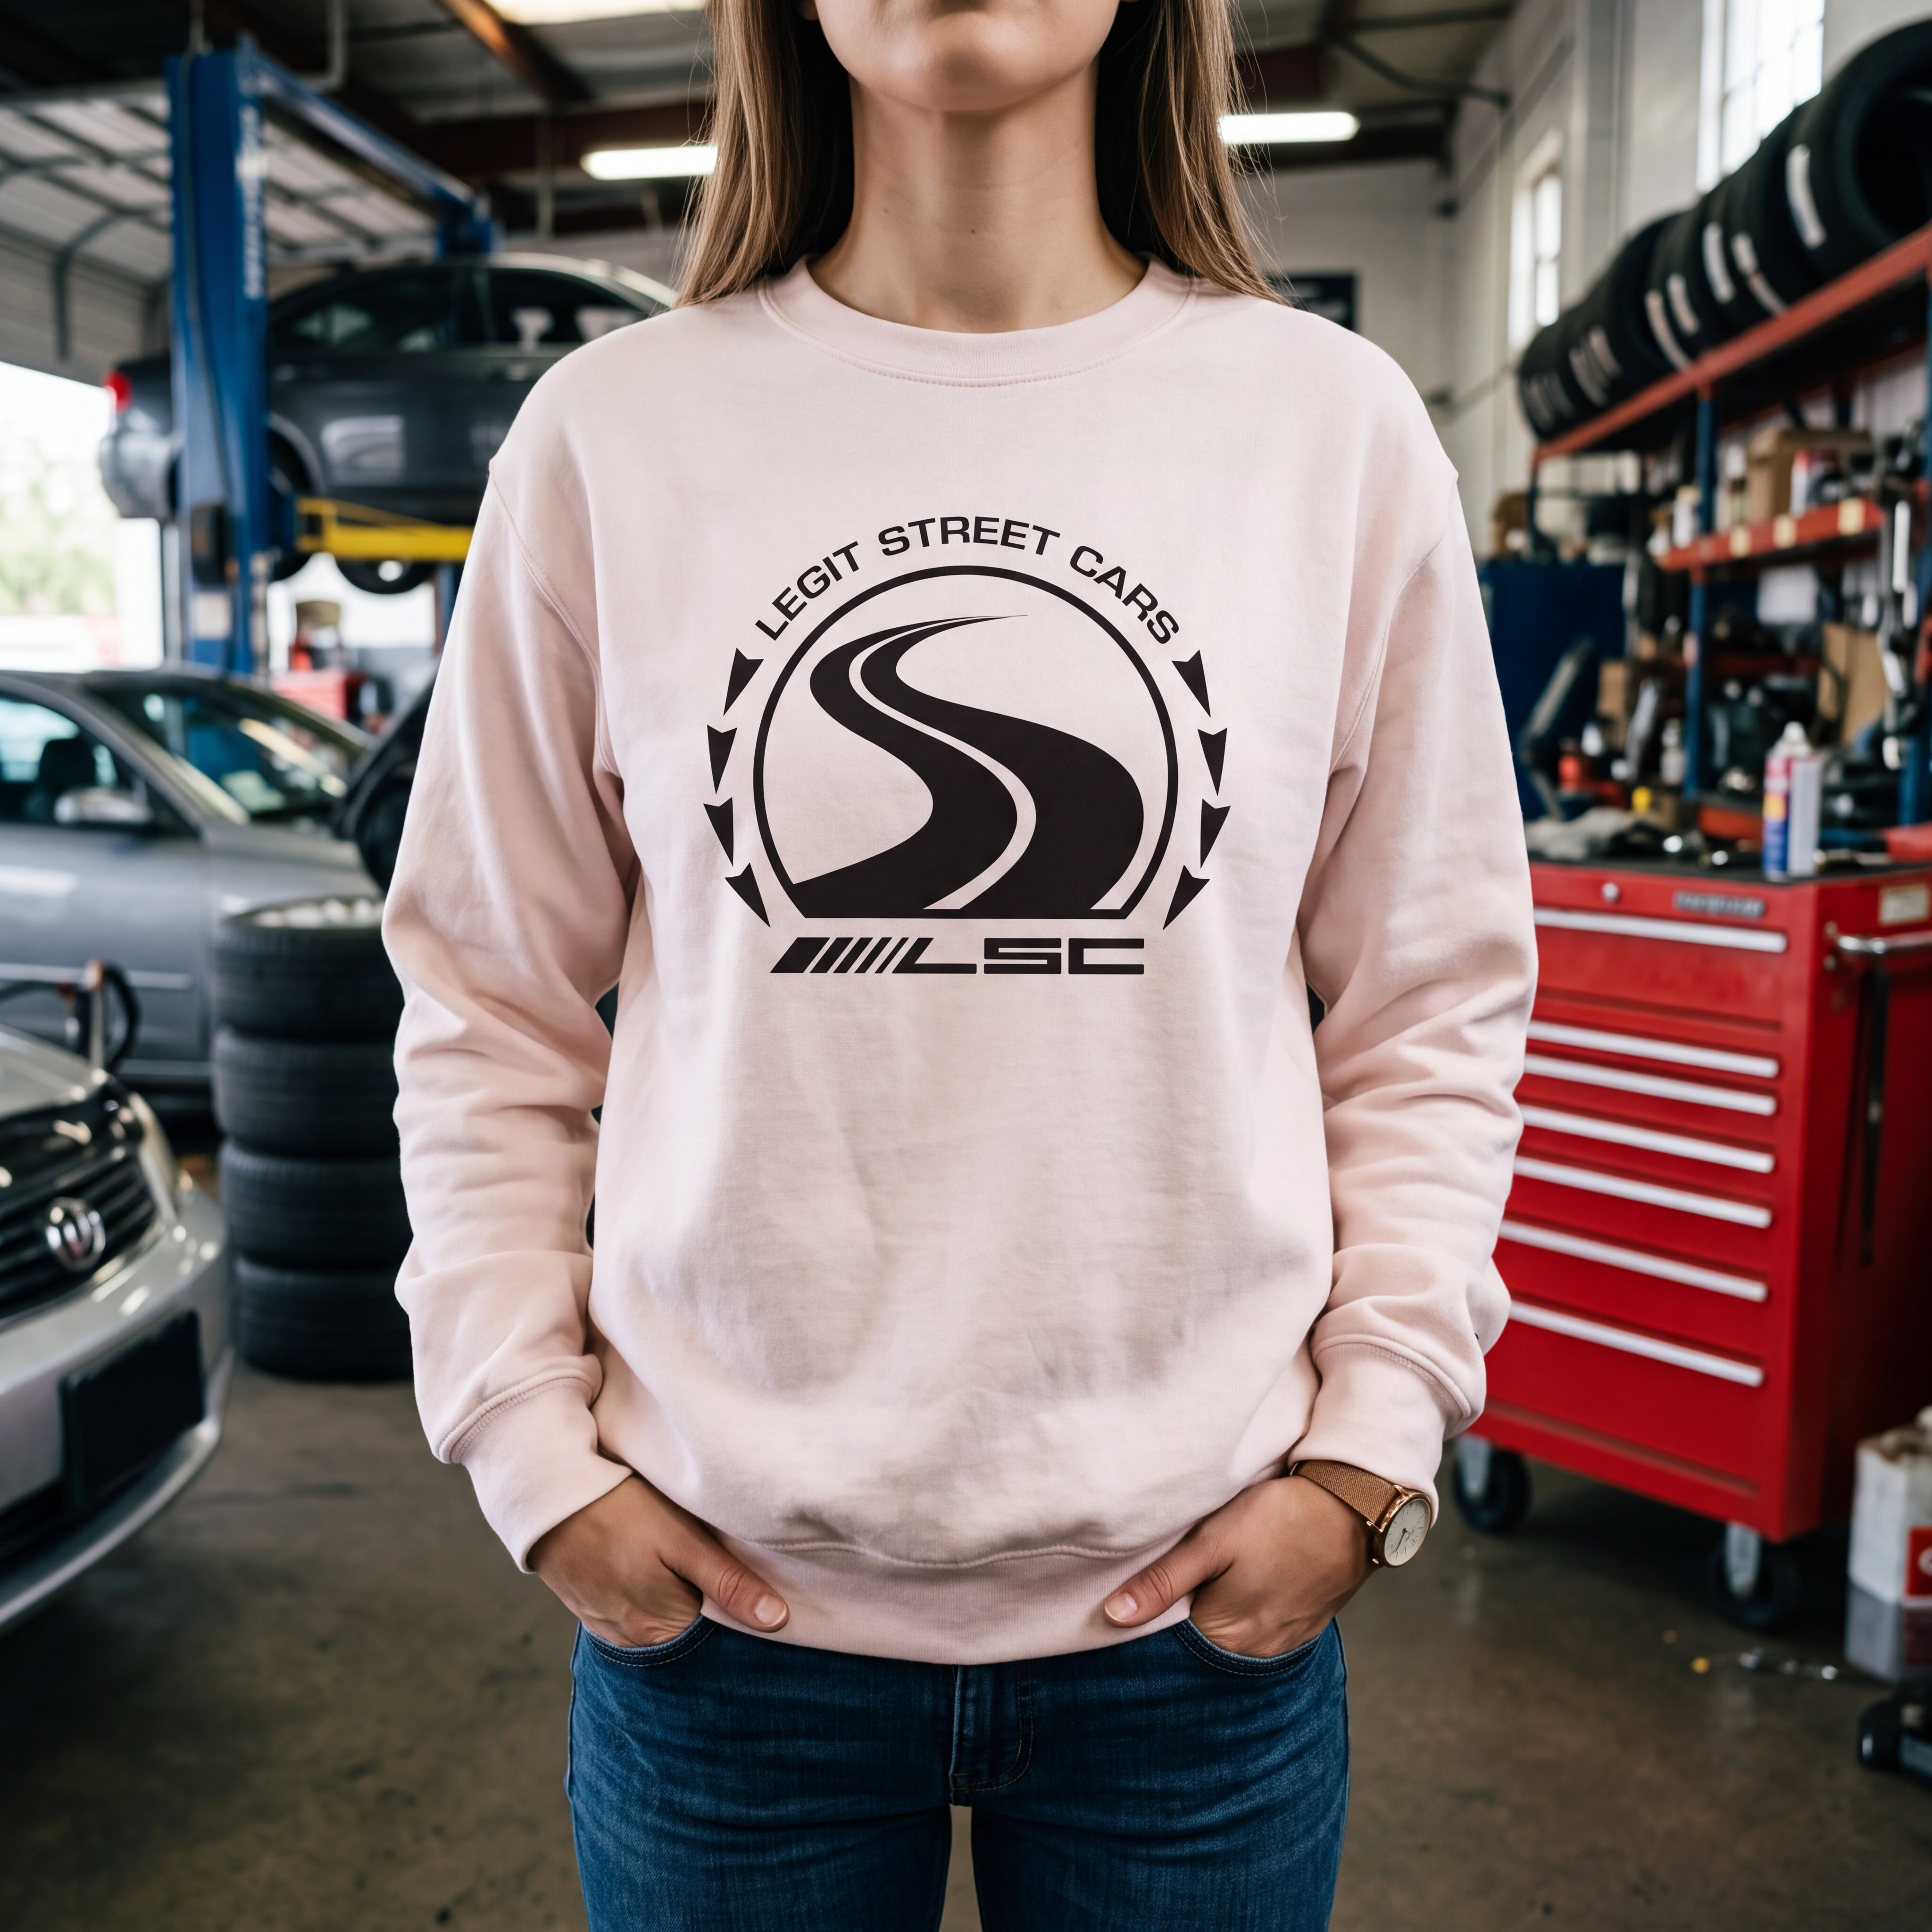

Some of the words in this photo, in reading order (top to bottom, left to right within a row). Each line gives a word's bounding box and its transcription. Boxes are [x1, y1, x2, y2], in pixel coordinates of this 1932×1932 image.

[755, 541, 859, 641] LEGIT
[878, 516, 1061, 556] STREET
[1070, 546, 1179, 644] CARS
[891, 937, 1145, 975] LSC
